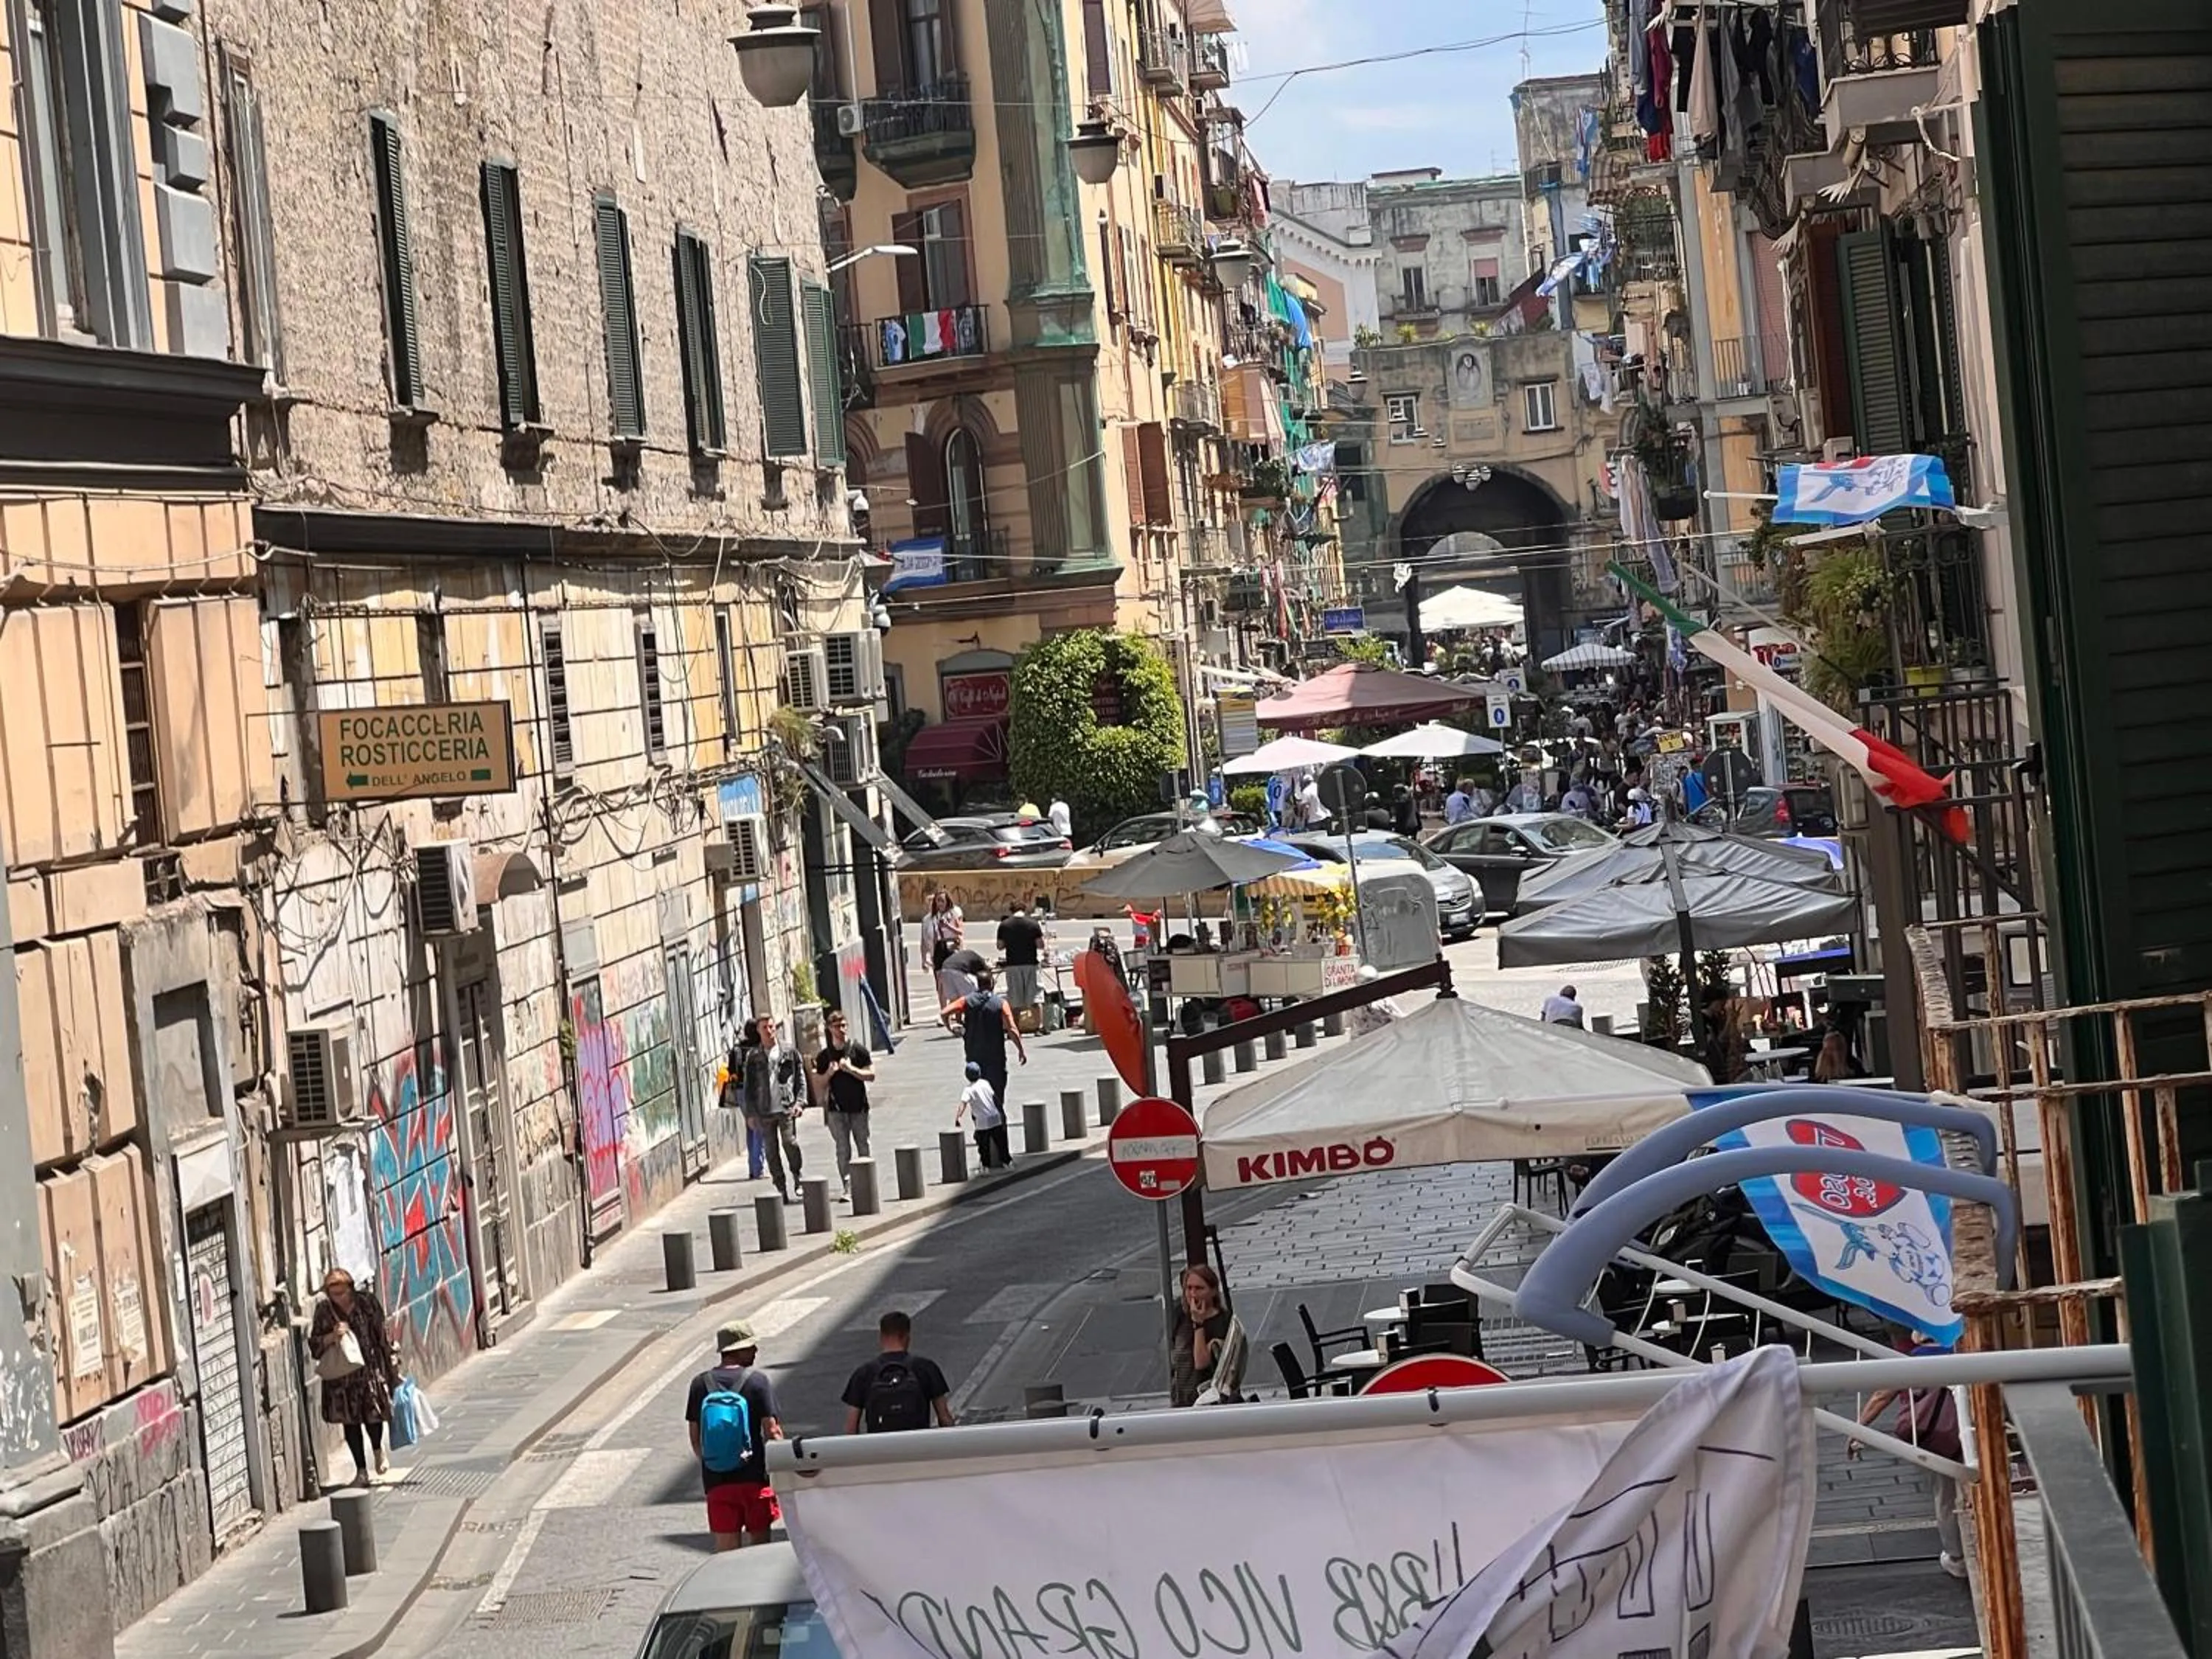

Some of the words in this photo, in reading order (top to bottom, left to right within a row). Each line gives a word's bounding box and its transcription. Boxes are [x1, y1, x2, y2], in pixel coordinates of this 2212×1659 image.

[341, 737, 490, 768] ROSTICCERIA
[413, 771, 466, 786] ANGELO
[1237, 1137, 1395, 1183] KIMBO
